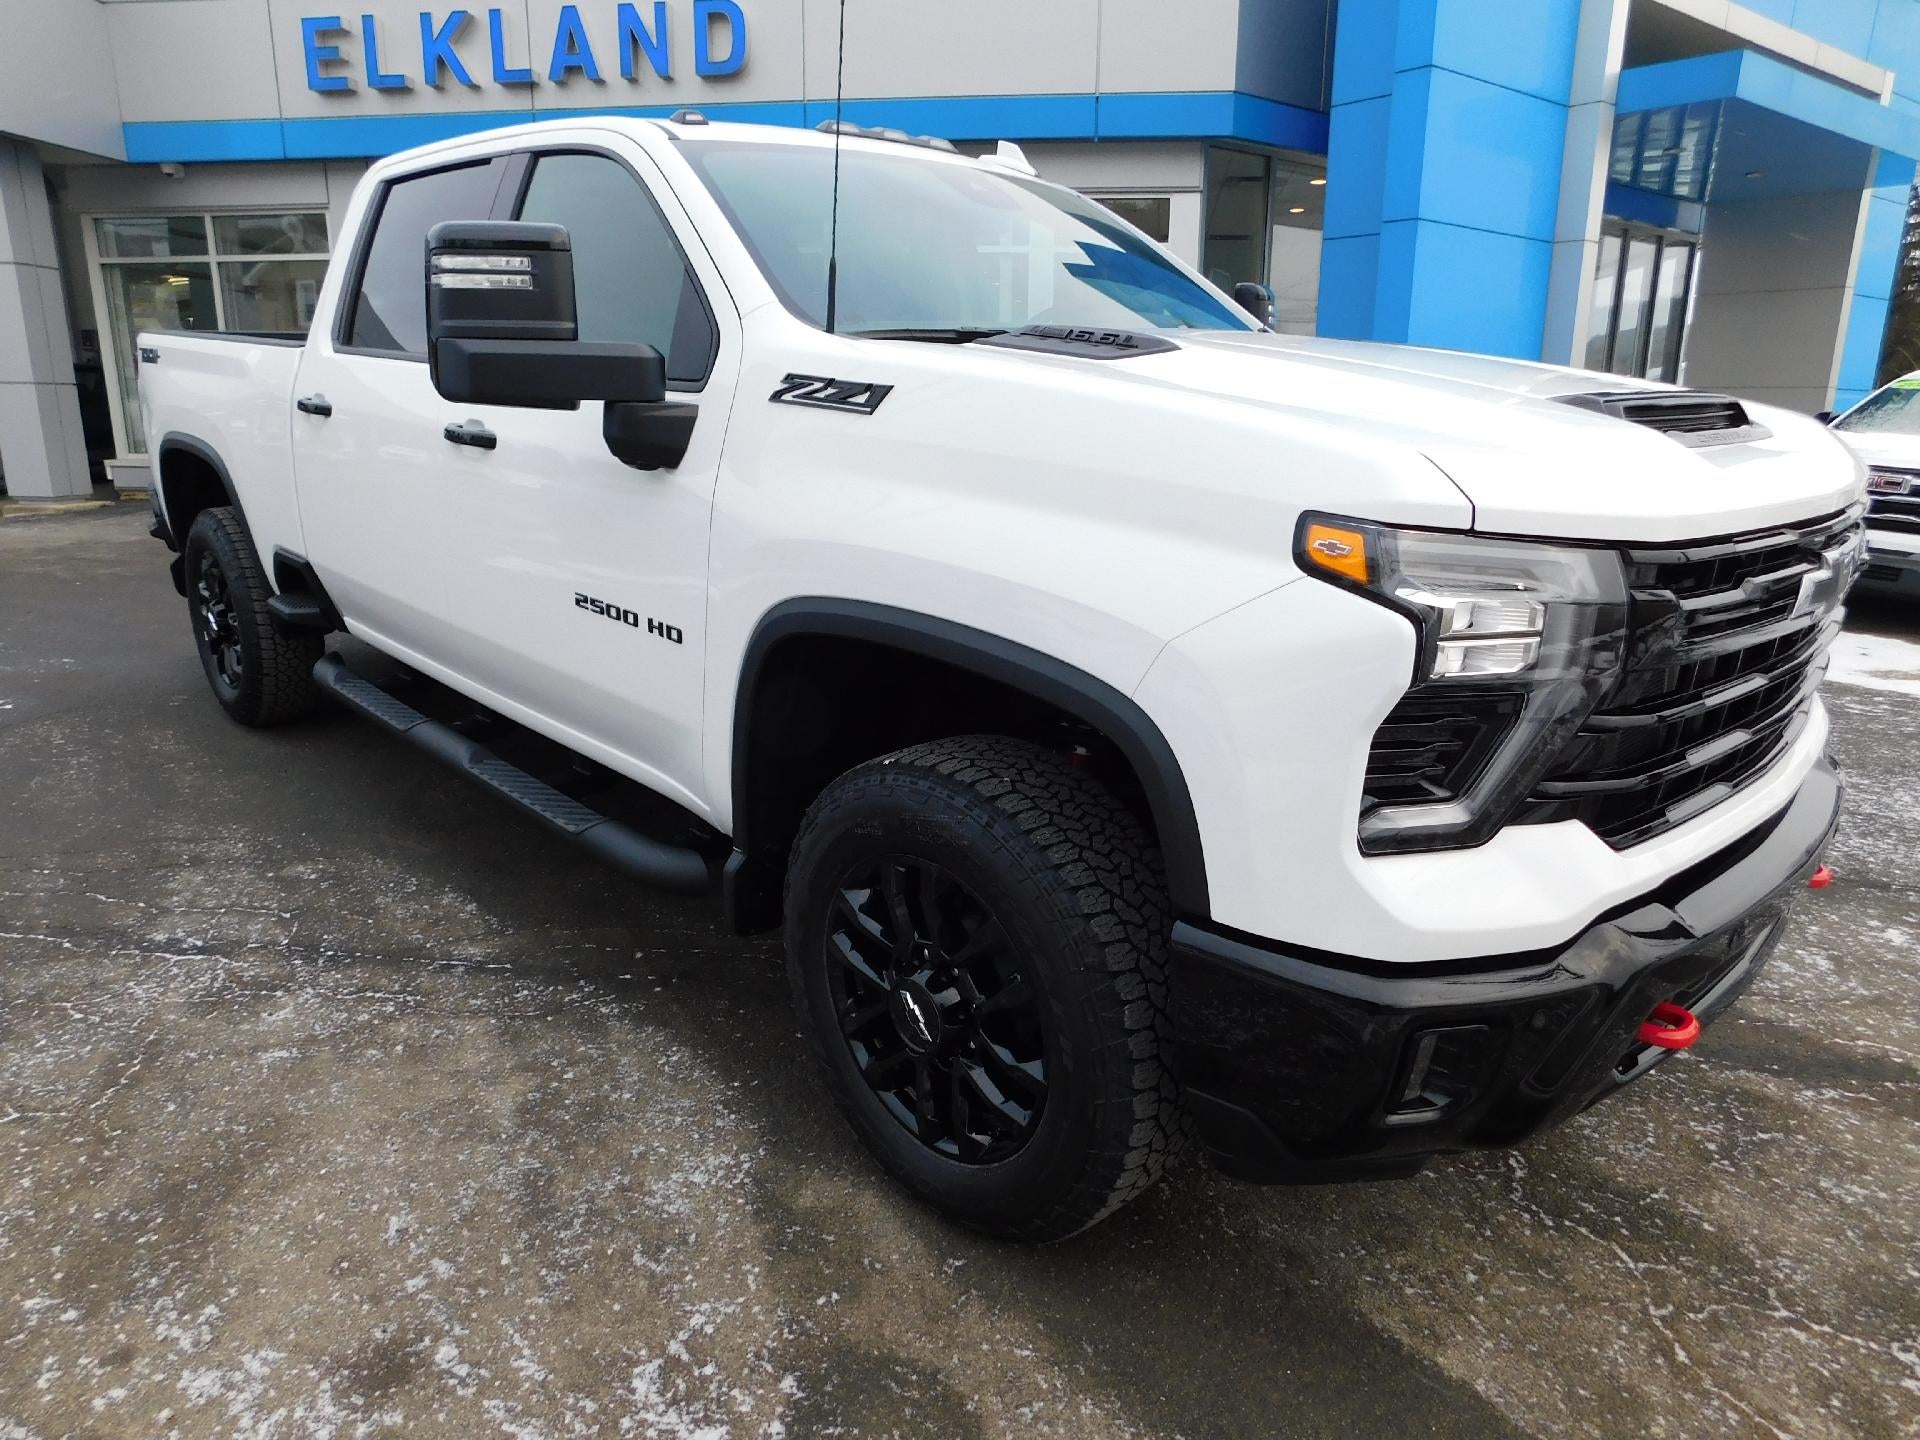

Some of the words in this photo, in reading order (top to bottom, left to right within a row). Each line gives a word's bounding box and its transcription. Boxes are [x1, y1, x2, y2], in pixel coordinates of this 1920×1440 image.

[301, 0, 746, 93] ELKLAND
[768, 372, 895, 416] Z71
[574, 591, 639, 628] 2500
[647, 616, 683, 645] HD
